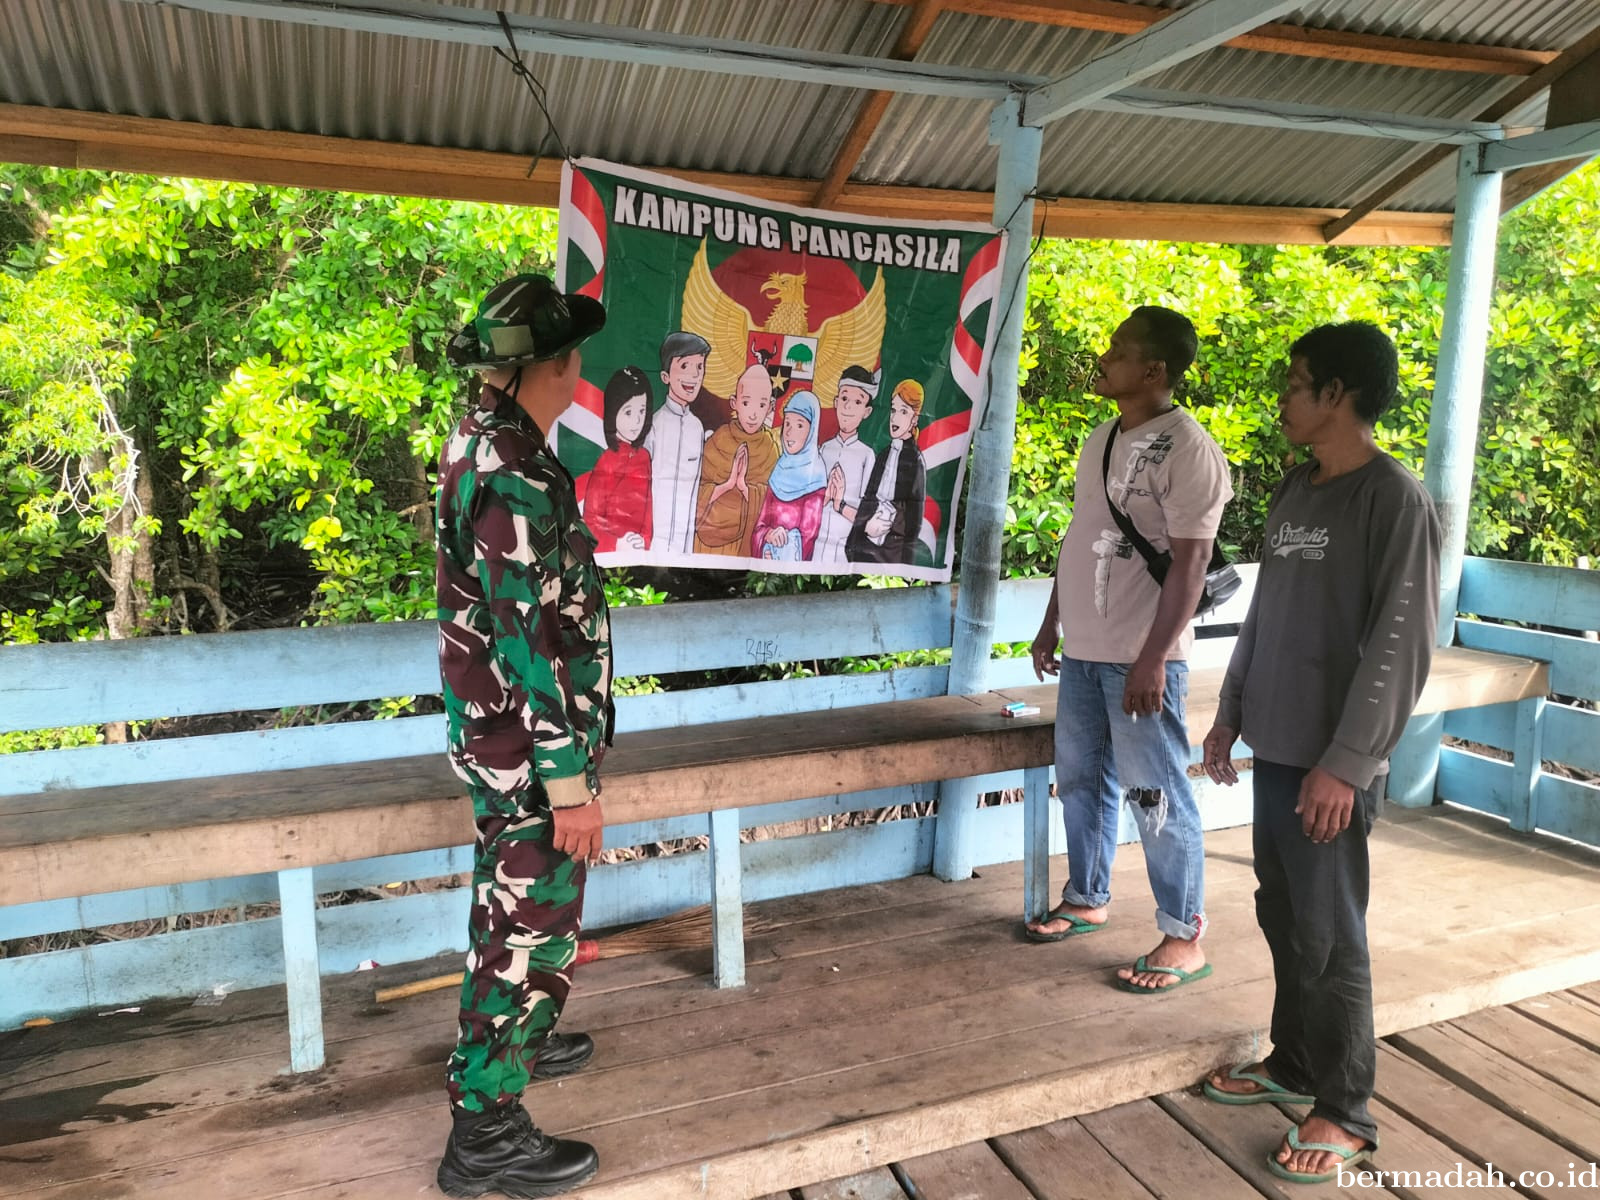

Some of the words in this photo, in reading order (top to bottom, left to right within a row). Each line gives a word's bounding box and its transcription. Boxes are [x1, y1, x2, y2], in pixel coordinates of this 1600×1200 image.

[613, 185, 781, 250] KAMPUNG
[790, 220, 962, 273] PANCASILA
[1271, 521, 1329, 548] Straight
